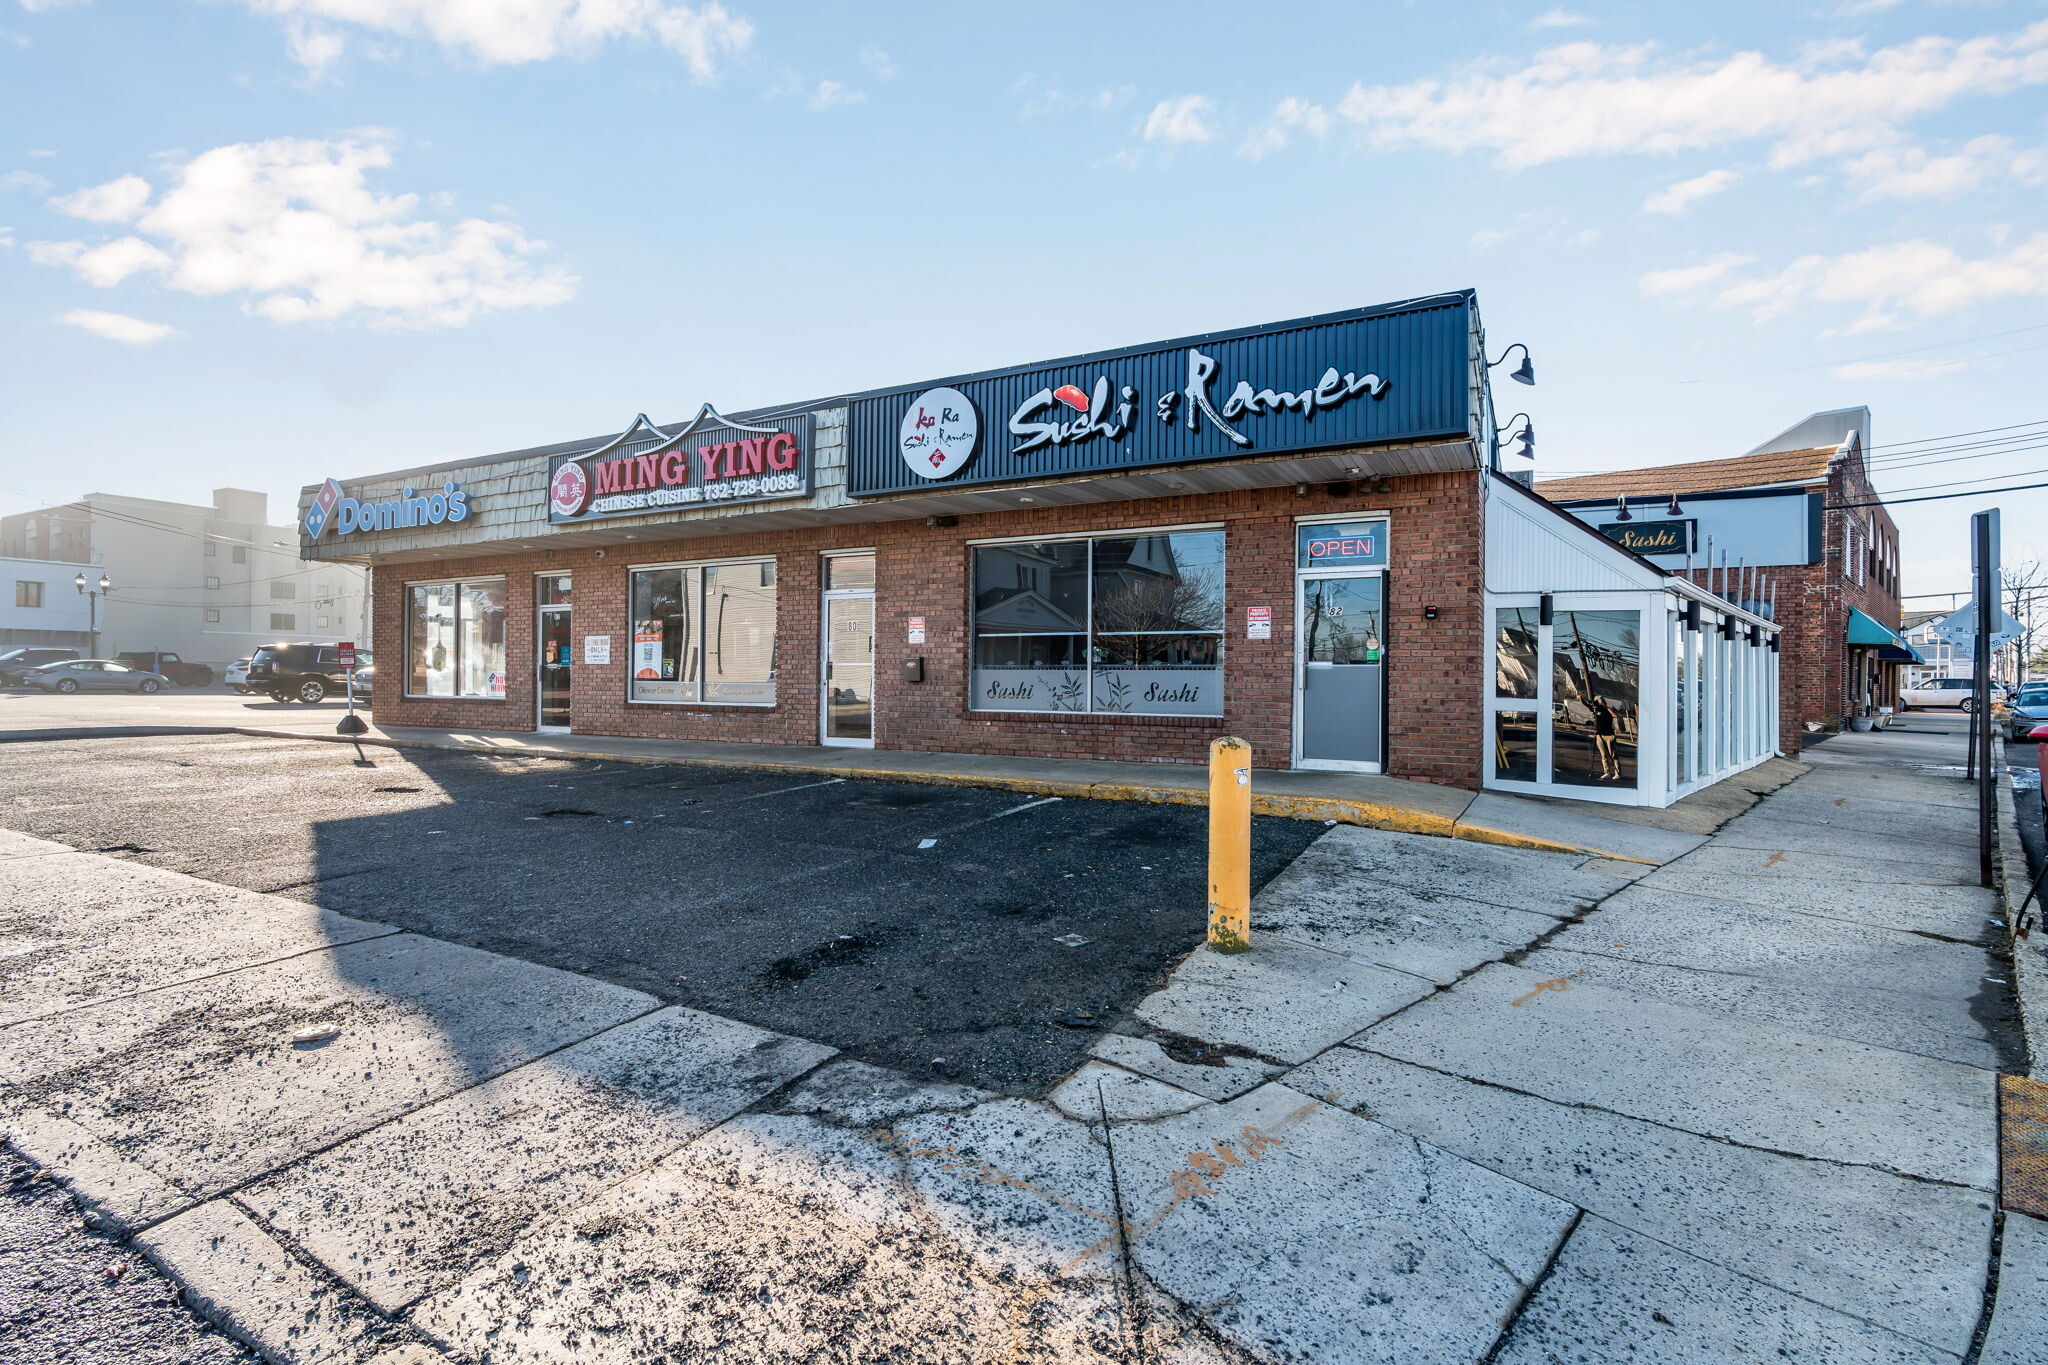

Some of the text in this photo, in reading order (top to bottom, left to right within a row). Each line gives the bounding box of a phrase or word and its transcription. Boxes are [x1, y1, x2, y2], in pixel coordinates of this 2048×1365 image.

[1009, 375, 1134, 454] Sushi
[1184, 348, 1390, 446] Ramen
[940, 407, 960, 425] Ra
[594, 432, 798, 495] MING YING
[593, 474, 798, 512] CHINESE CUISINE 732-728-0088
[338, 481, 472, 536] Domino's
[1310, 539, 1371, 557] OPEN
[1618, 529, 1677, 548] Sushi
[1329, 607, 1343, 616] 82
[848, 621, 857, 631] 80
[986, 680, 1034, 699] Sushi
[1144, 681, 1200, 703] Sushi
